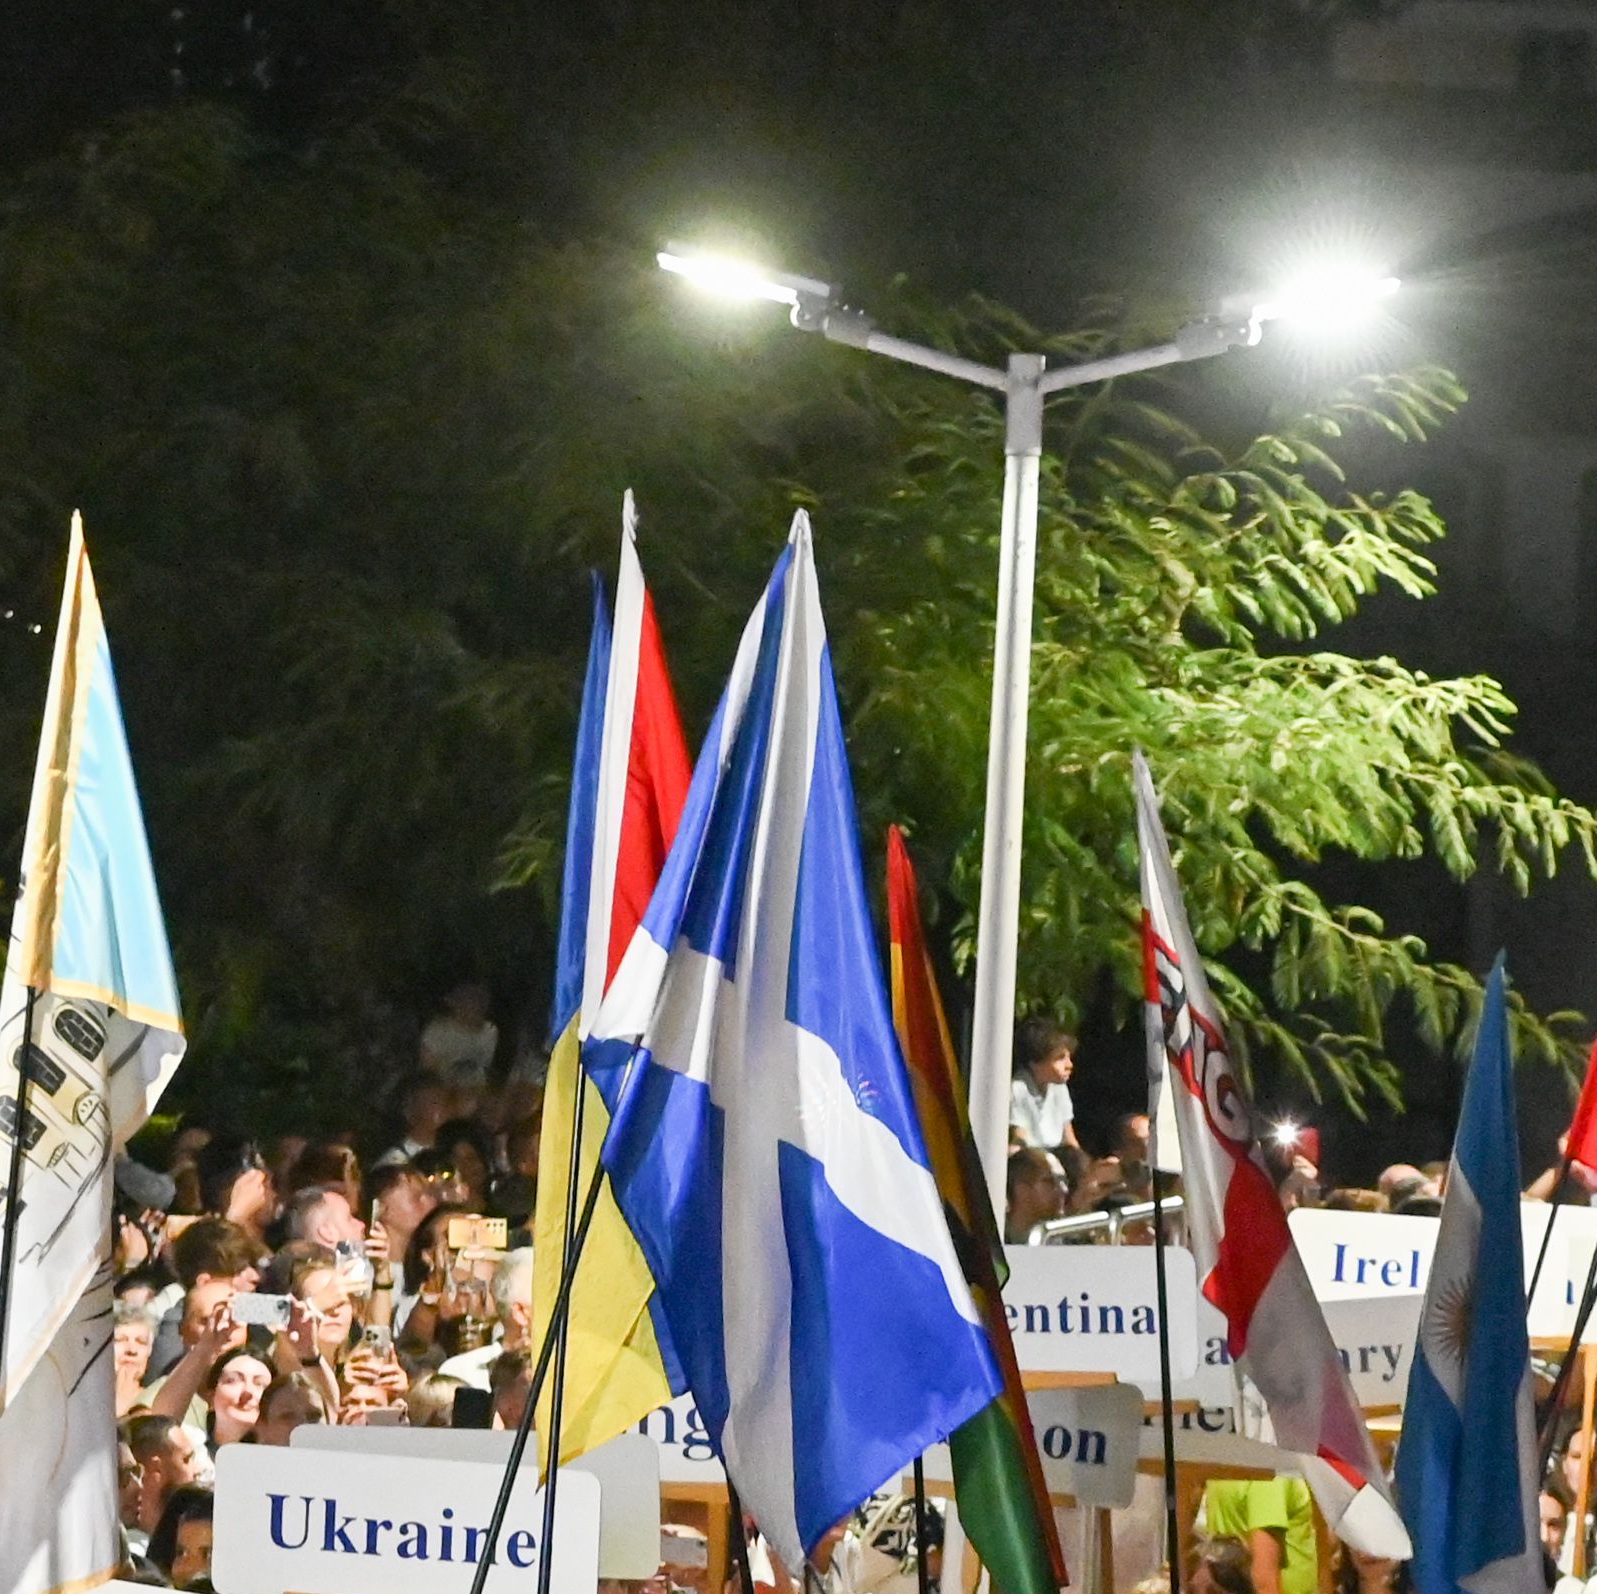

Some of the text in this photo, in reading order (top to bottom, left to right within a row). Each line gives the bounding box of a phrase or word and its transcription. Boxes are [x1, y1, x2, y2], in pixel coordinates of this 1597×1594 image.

[1331, 1242, 1420, 1289] Irel
[1003, 1291, 1157, 1335] entina
[265, 1492, 537, 1569] Ukraine
